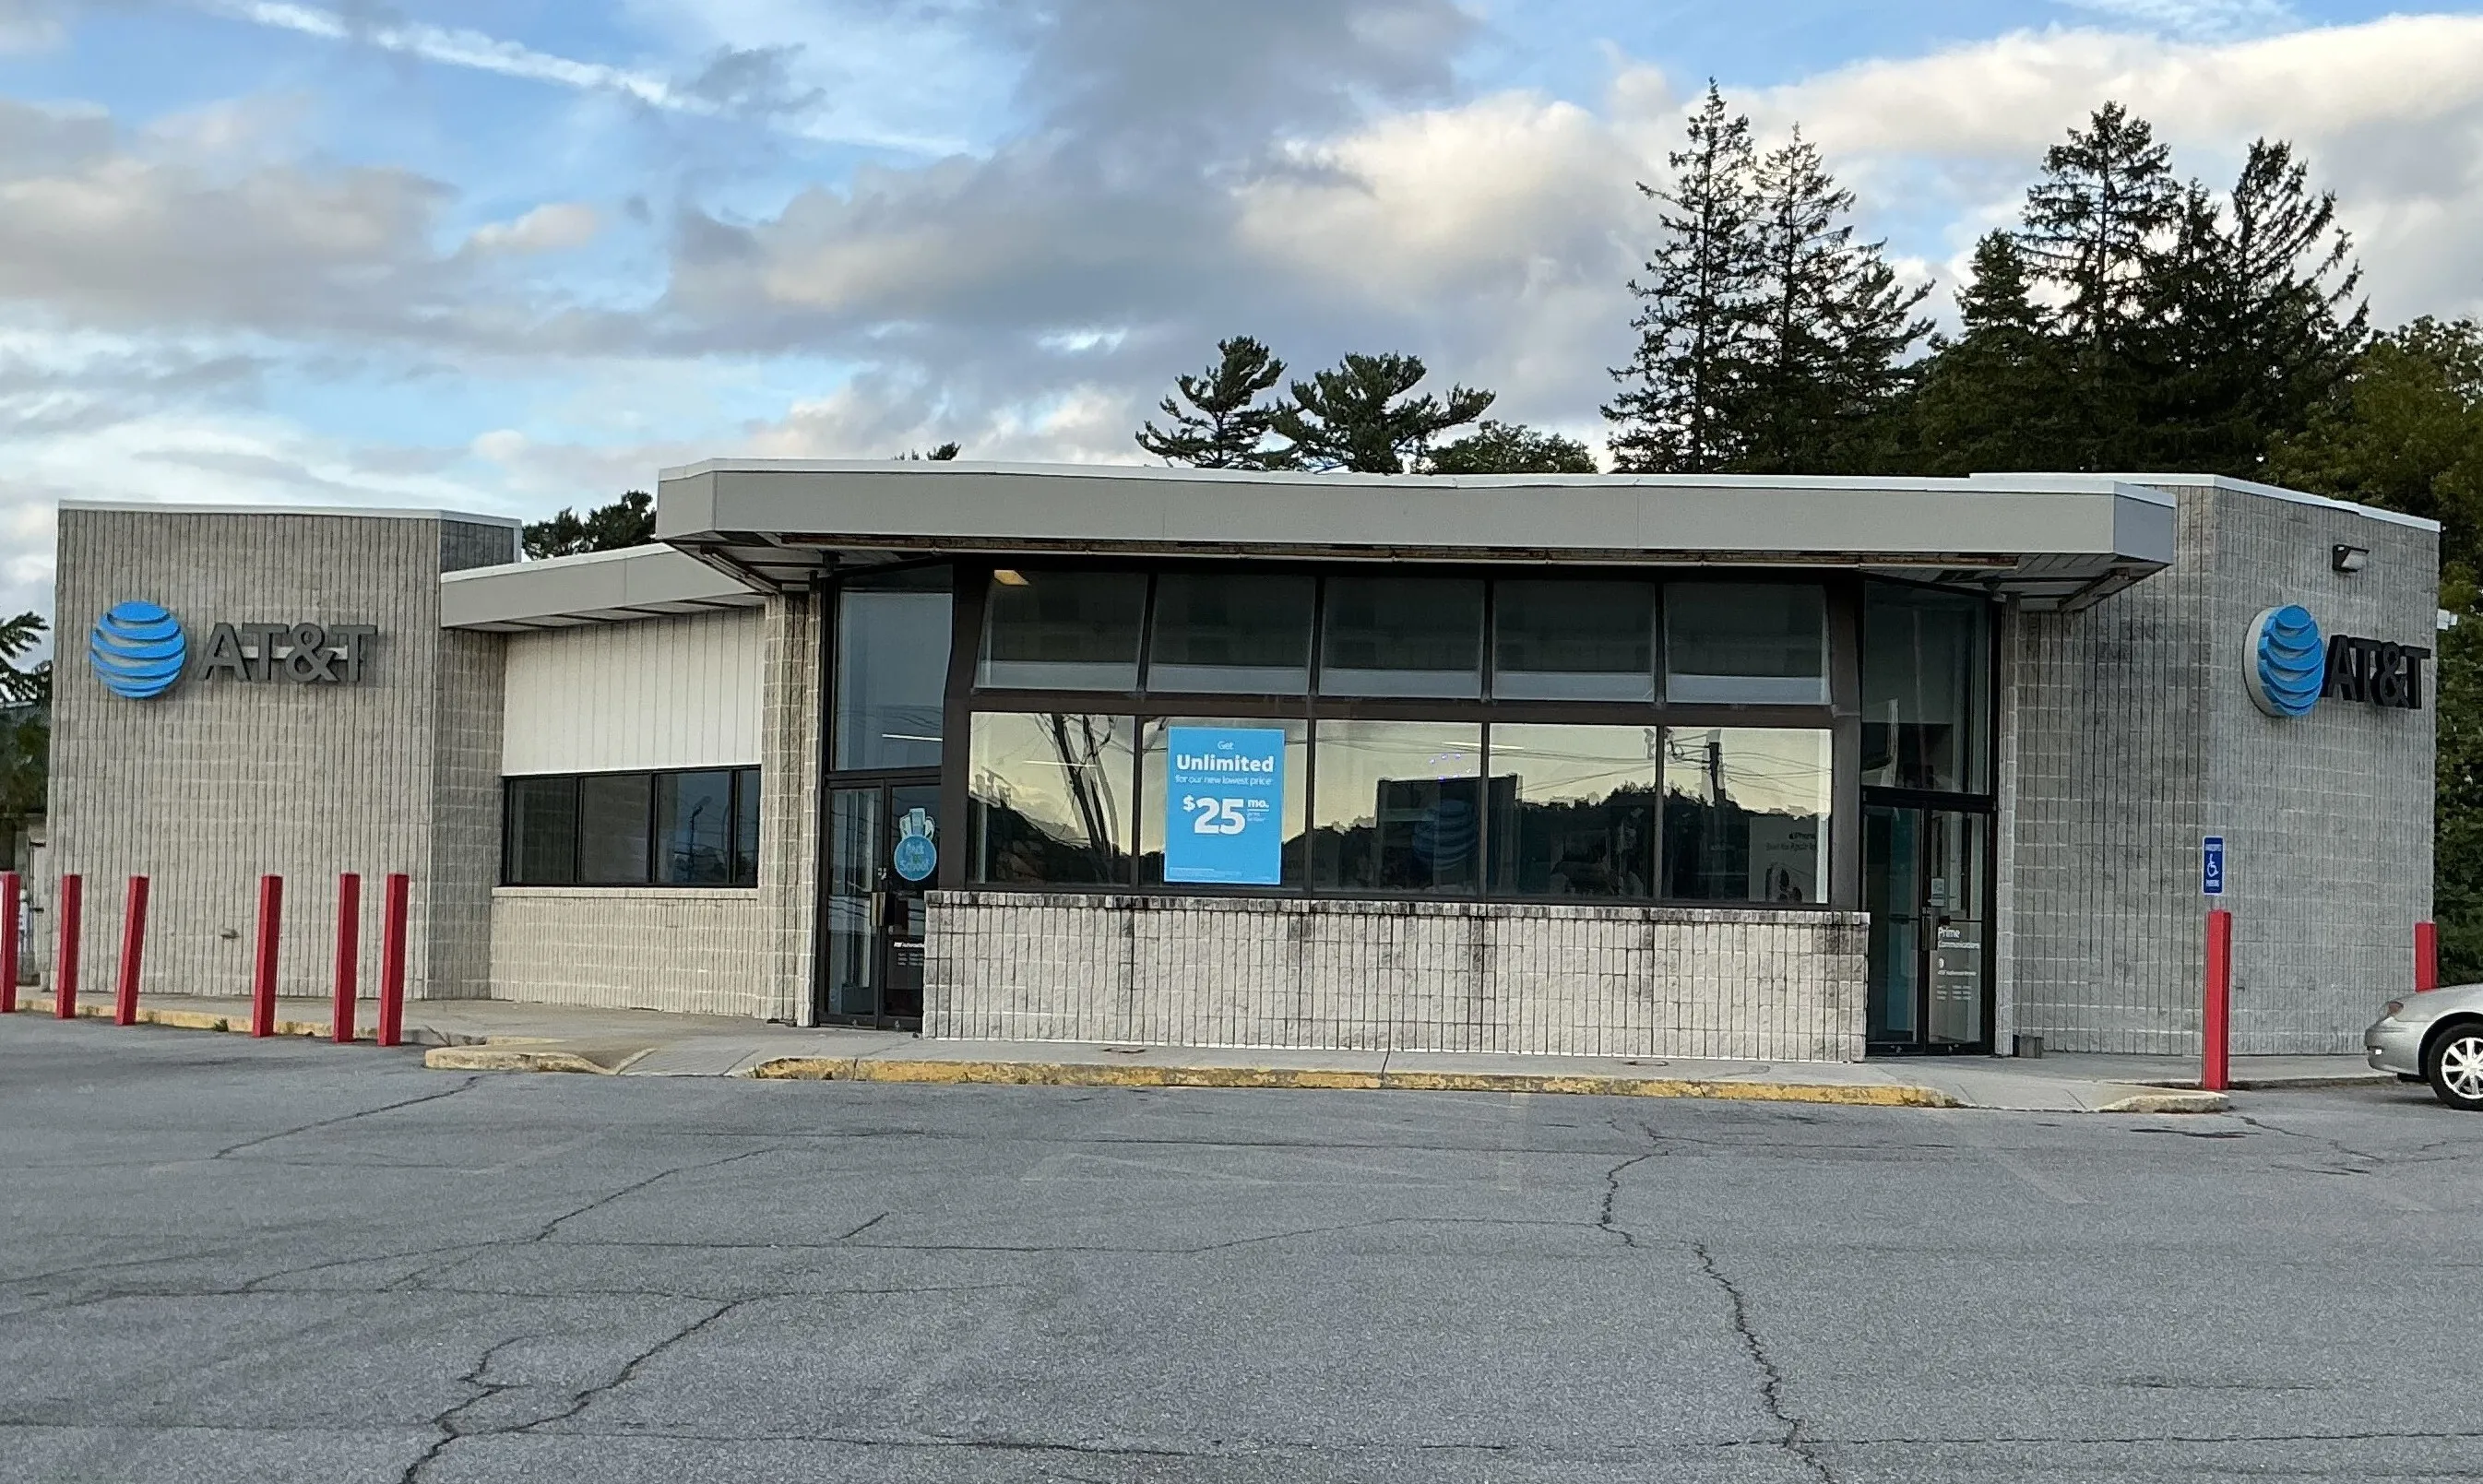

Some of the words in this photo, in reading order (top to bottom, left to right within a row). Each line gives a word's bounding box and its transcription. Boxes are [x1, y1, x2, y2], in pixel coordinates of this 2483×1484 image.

[197, 623, 378, 683] AT&T
[2318, 634, 2431, 709] AT&T
[1218, 741, 1234, 750] Get
[1176, 754, 1274, 773] Unlimited
[1175, 775, 1188, 784] for
[1187, 777, 1202, 785] our
[1204, 777, 1221, 785] new
[1222, 777, 1249, 786] lowest
[1250, 778, 1272, 787] price
[1182, 794, 1246, 835] $25
[1247, 799, 1270, 808] mo.
